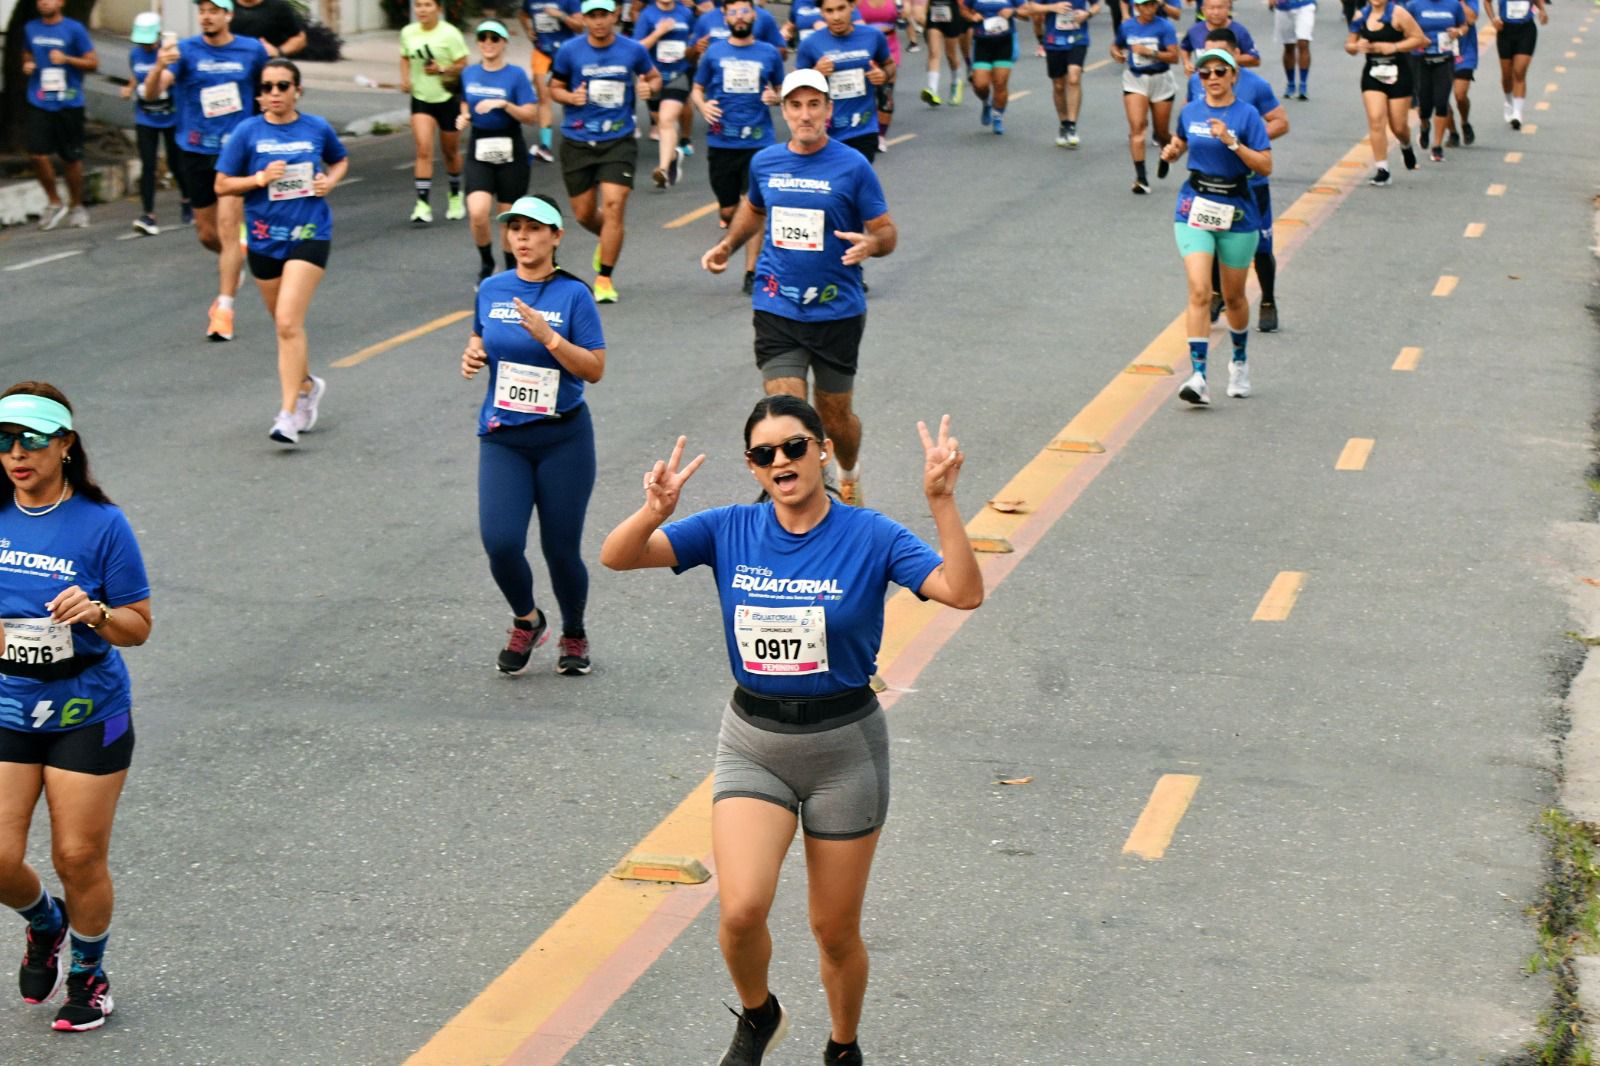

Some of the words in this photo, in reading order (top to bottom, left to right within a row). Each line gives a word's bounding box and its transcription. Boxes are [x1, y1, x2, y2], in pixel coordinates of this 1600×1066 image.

[782, 227, 809, 240] 1294
[509, 386, 539, 403] 0611
[731, 573, 844, 594] EQUATORIAL
[7, 643, 54, 665] 0976
[755, 638, 802, 660] 0917
